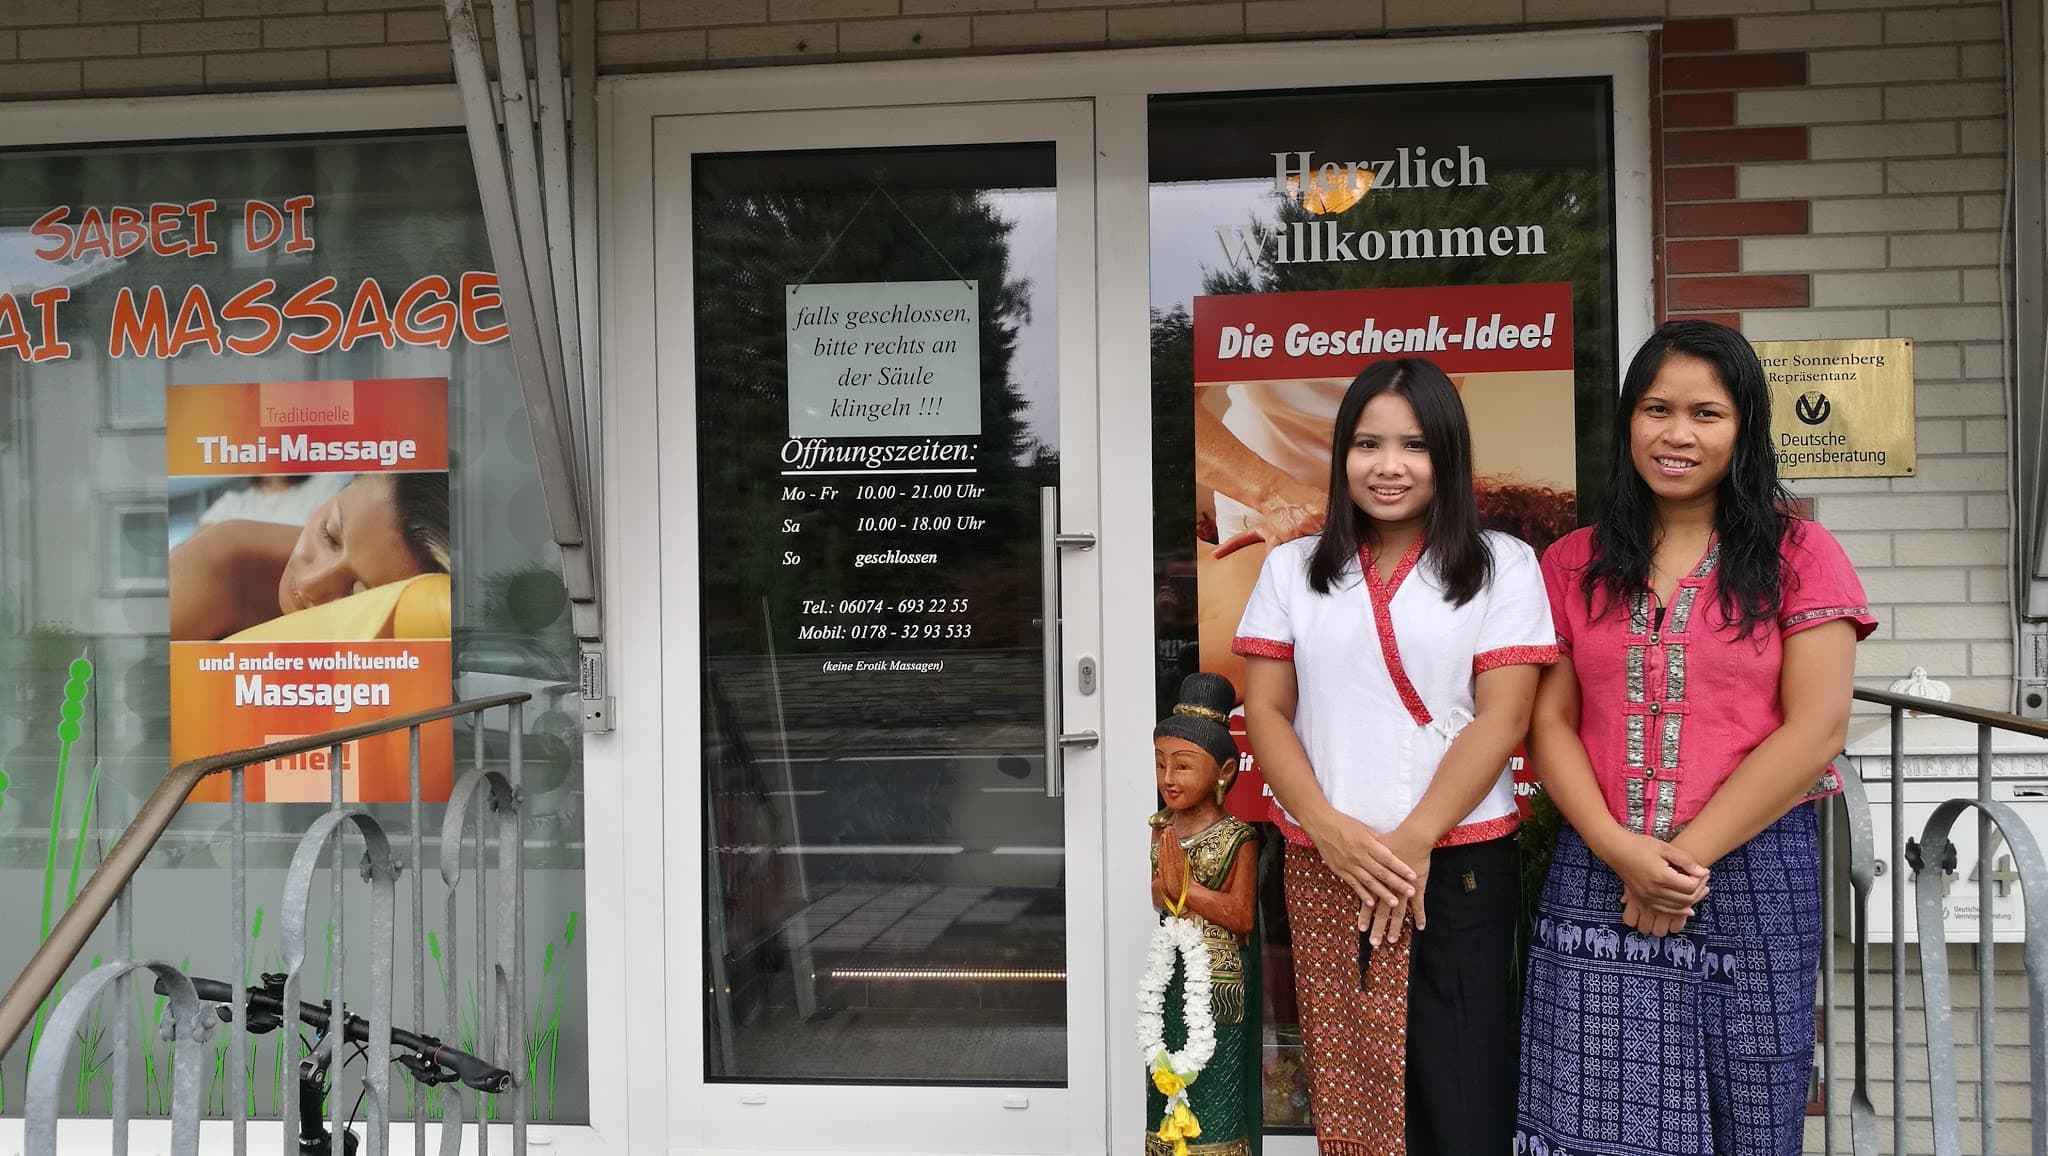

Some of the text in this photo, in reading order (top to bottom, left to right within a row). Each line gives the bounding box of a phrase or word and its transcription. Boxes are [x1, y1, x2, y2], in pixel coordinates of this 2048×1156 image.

[1270, 145, 1488, 193] Herzlich
[30, 195, 315, 262] SABEI DI
[1216, 220, 1546, 268] Willkommen
[108, 270, 510, 358] MASSAGE
[792, 304, 971, 331] falls geschlossen,
[813, 336, 956, 356] bitte rechts an
[1217, 313, 1555, 359] Die Geschenk-Idee!
[1758, 353, 1885, 367] iner Sonnenberg
[838, 366, 934, 386] der Säule
[1768, 371, 1857, 385] Repräsentanz
[266, 406, 350, 423] Traditionelle
[830, 396, 943, 422] klingeln !!!
[1781, 432, 1846, 446] Deutsche
[196, 433, 416, 466] Thai-Massage
[780, 435, 978, 469] Öffnungszeiten:
[781, 486, 806, 501] Mo
[819, 486, 839, 500] Fr
[856, 485, 896, 500] 10.00
[911, 484, 951, 499] 21.00
[956, 484, 985, 499] Uhr
[782, 518, 801, 533] Sa
[857, 517, 897, 532] 10.00
[912, 516, 951, 531] 18.00
[957, 516, 986, 530] Uhr
[782, 550, 938, 567] So geschlossen
[802, 600, 834, 614] Tel.:
[839, 600, 883, 614] 06074
[898, 600, 924, 613] 693
[928, 599, 947, 613] 22
[950, 598, 969, 613] 55
[798, 625, 846, 640] Mobil:
[851, 625, 887, 639] 0178
[900, 625, 919, 639] 32
[922, 625, 941, 638] 93
[945, 624, 972, 638] 533
[199, 649, 419, 671] und andere wohltuende
[822, 660, 944, 673] (keine Erotik Massagen)
[235, 674, 390, 713] Massagen
